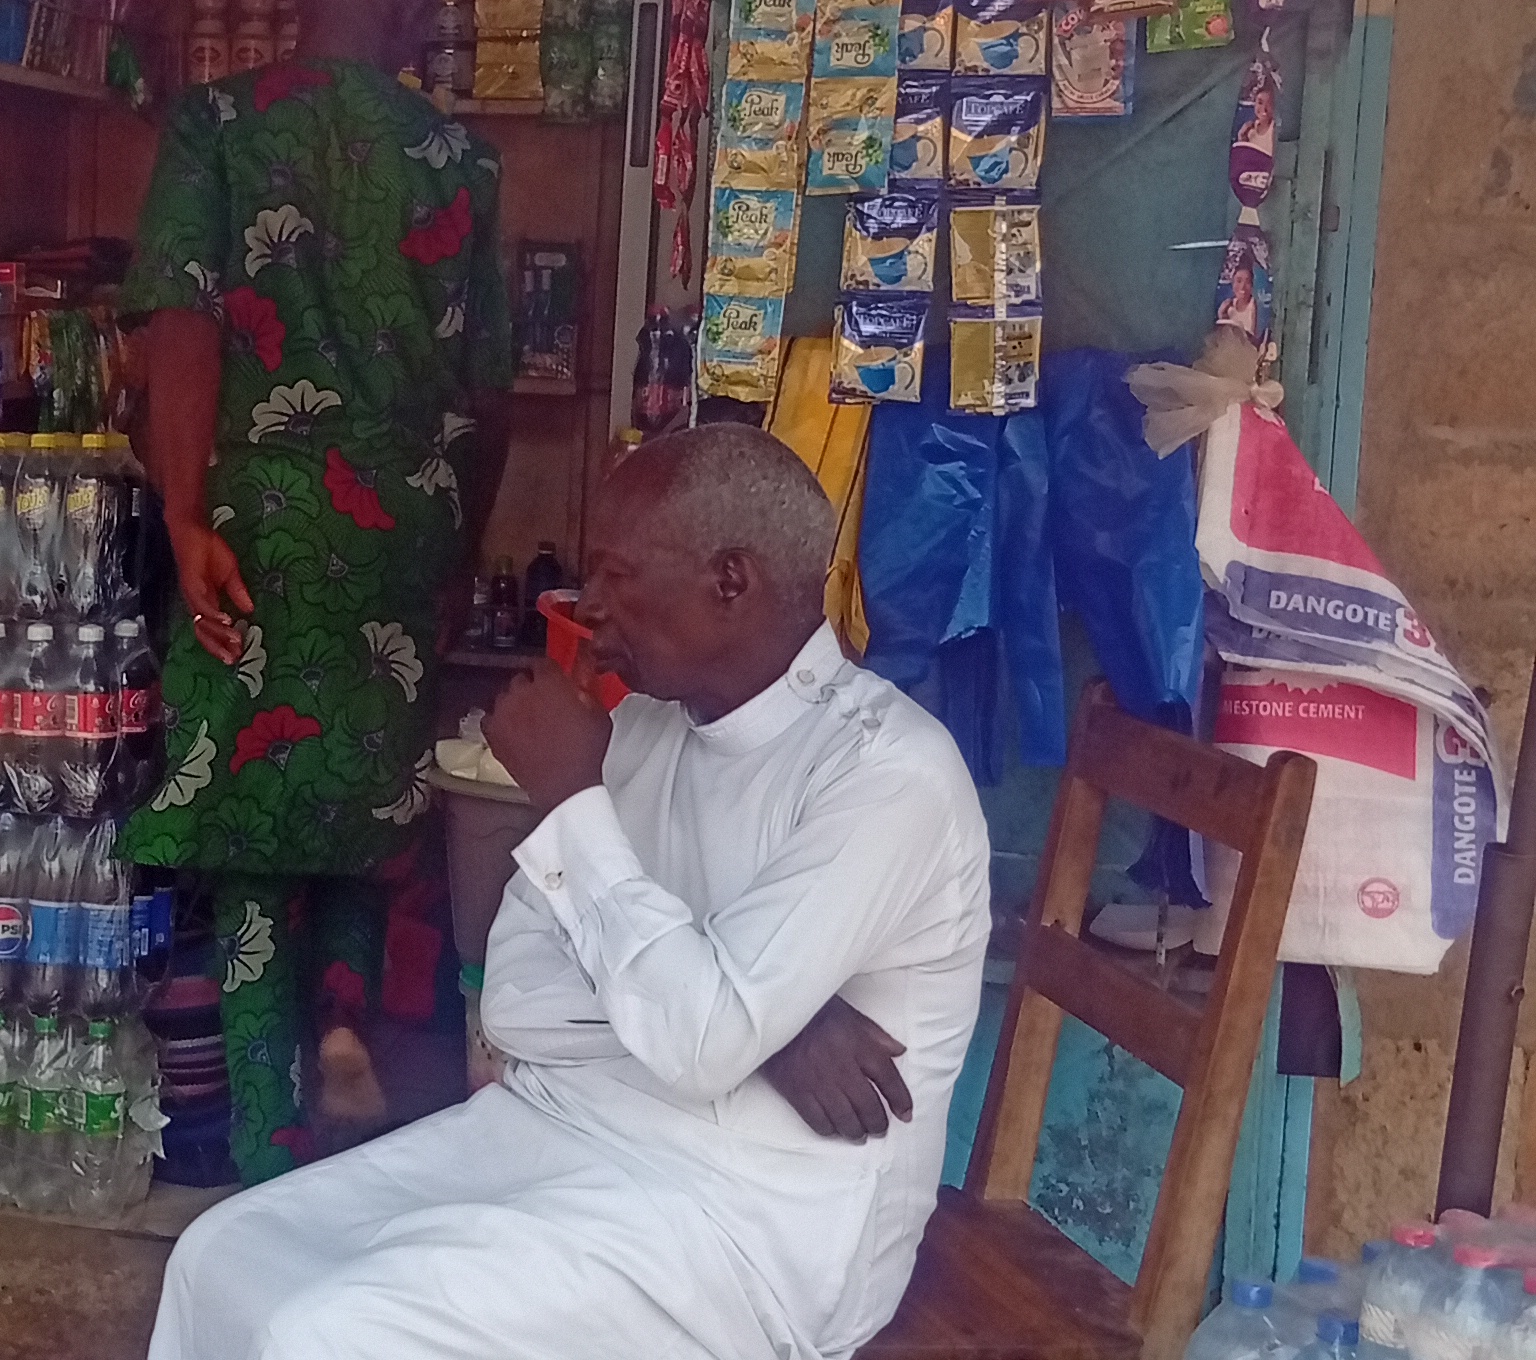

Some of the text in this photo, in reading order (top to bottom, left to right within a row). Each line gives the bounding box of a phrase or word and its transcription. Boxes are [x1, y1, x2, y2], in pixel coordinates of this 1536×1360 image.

[744, 93, 779, 117] Peak
[731, 201, 769, 225] Peak
[723, 307, 759, 332] Peak
[1269, 590, 1392, 631] DANGOTE
[1298, 702, 1366, 720] CEMENT
[1453, 769, 1476, 885] DANGOTE
